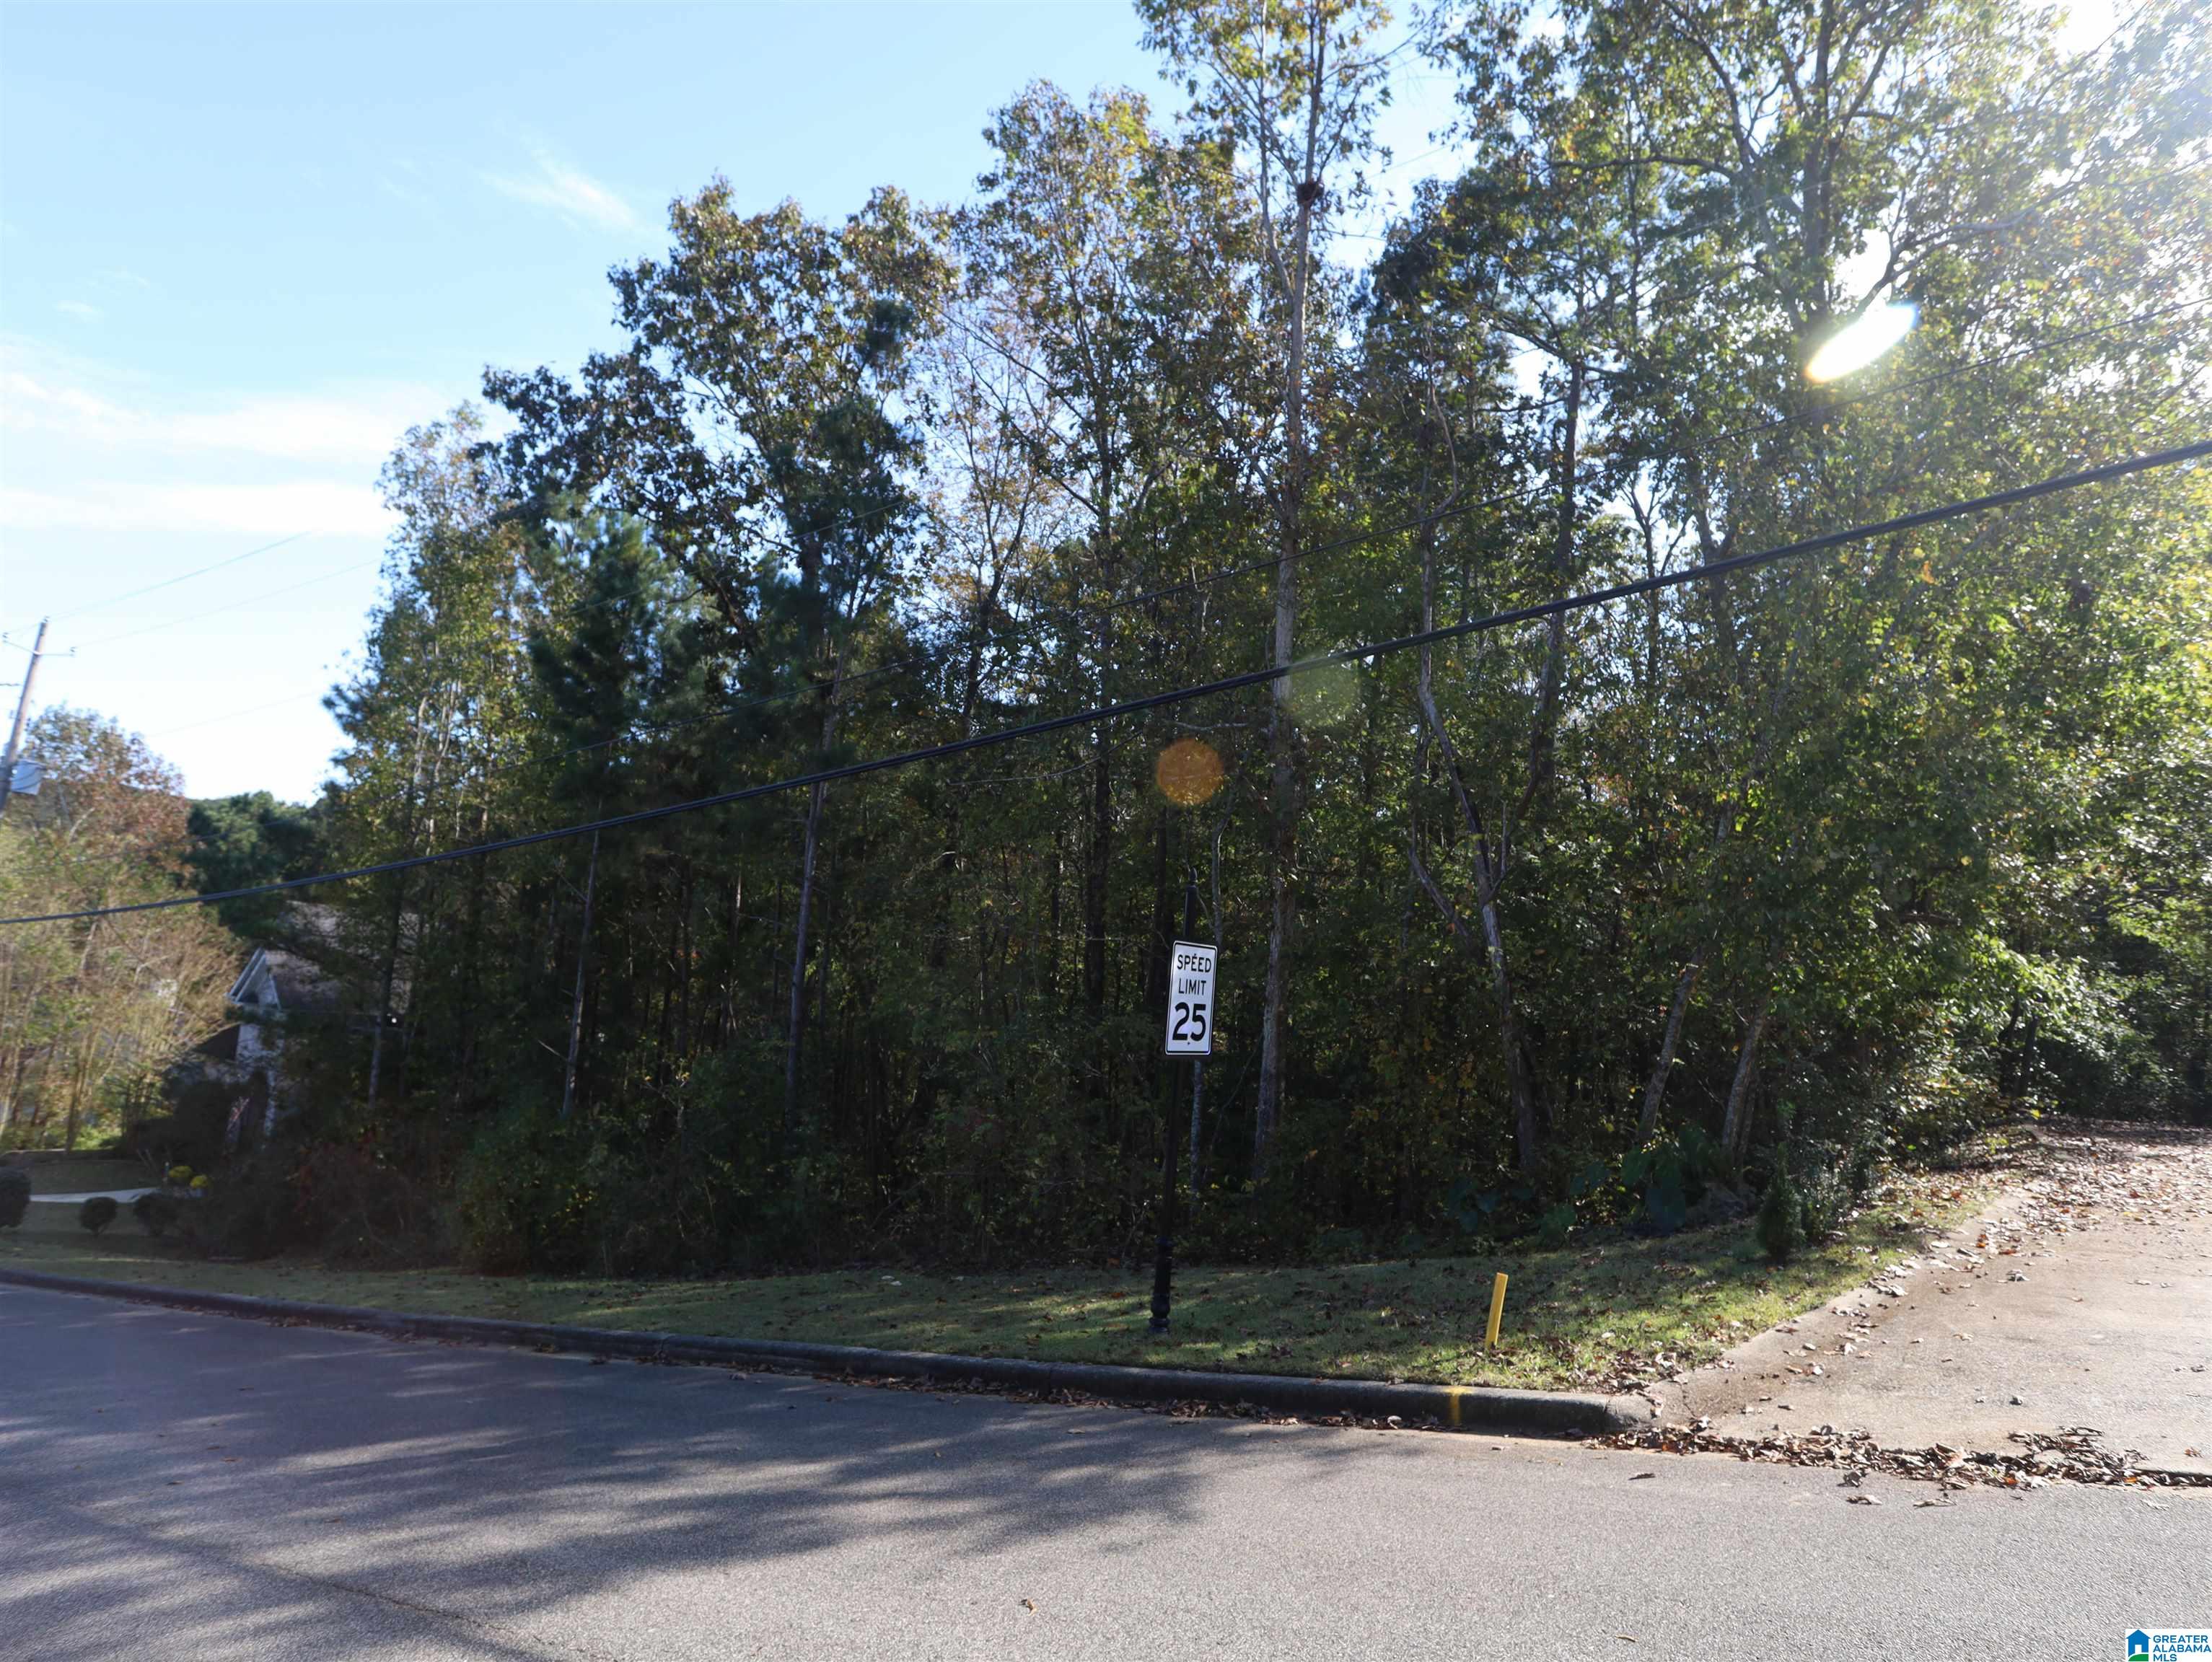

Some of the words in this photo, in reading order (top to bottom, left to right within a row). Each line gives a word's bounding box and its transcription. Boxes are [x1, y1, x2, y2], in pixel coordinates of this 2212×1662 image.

[1177, 954, 1212, 973] SPEED
[1178, 978, 1206, 995] LIMIT
[1172, 1002, 1206, 1042] 25
